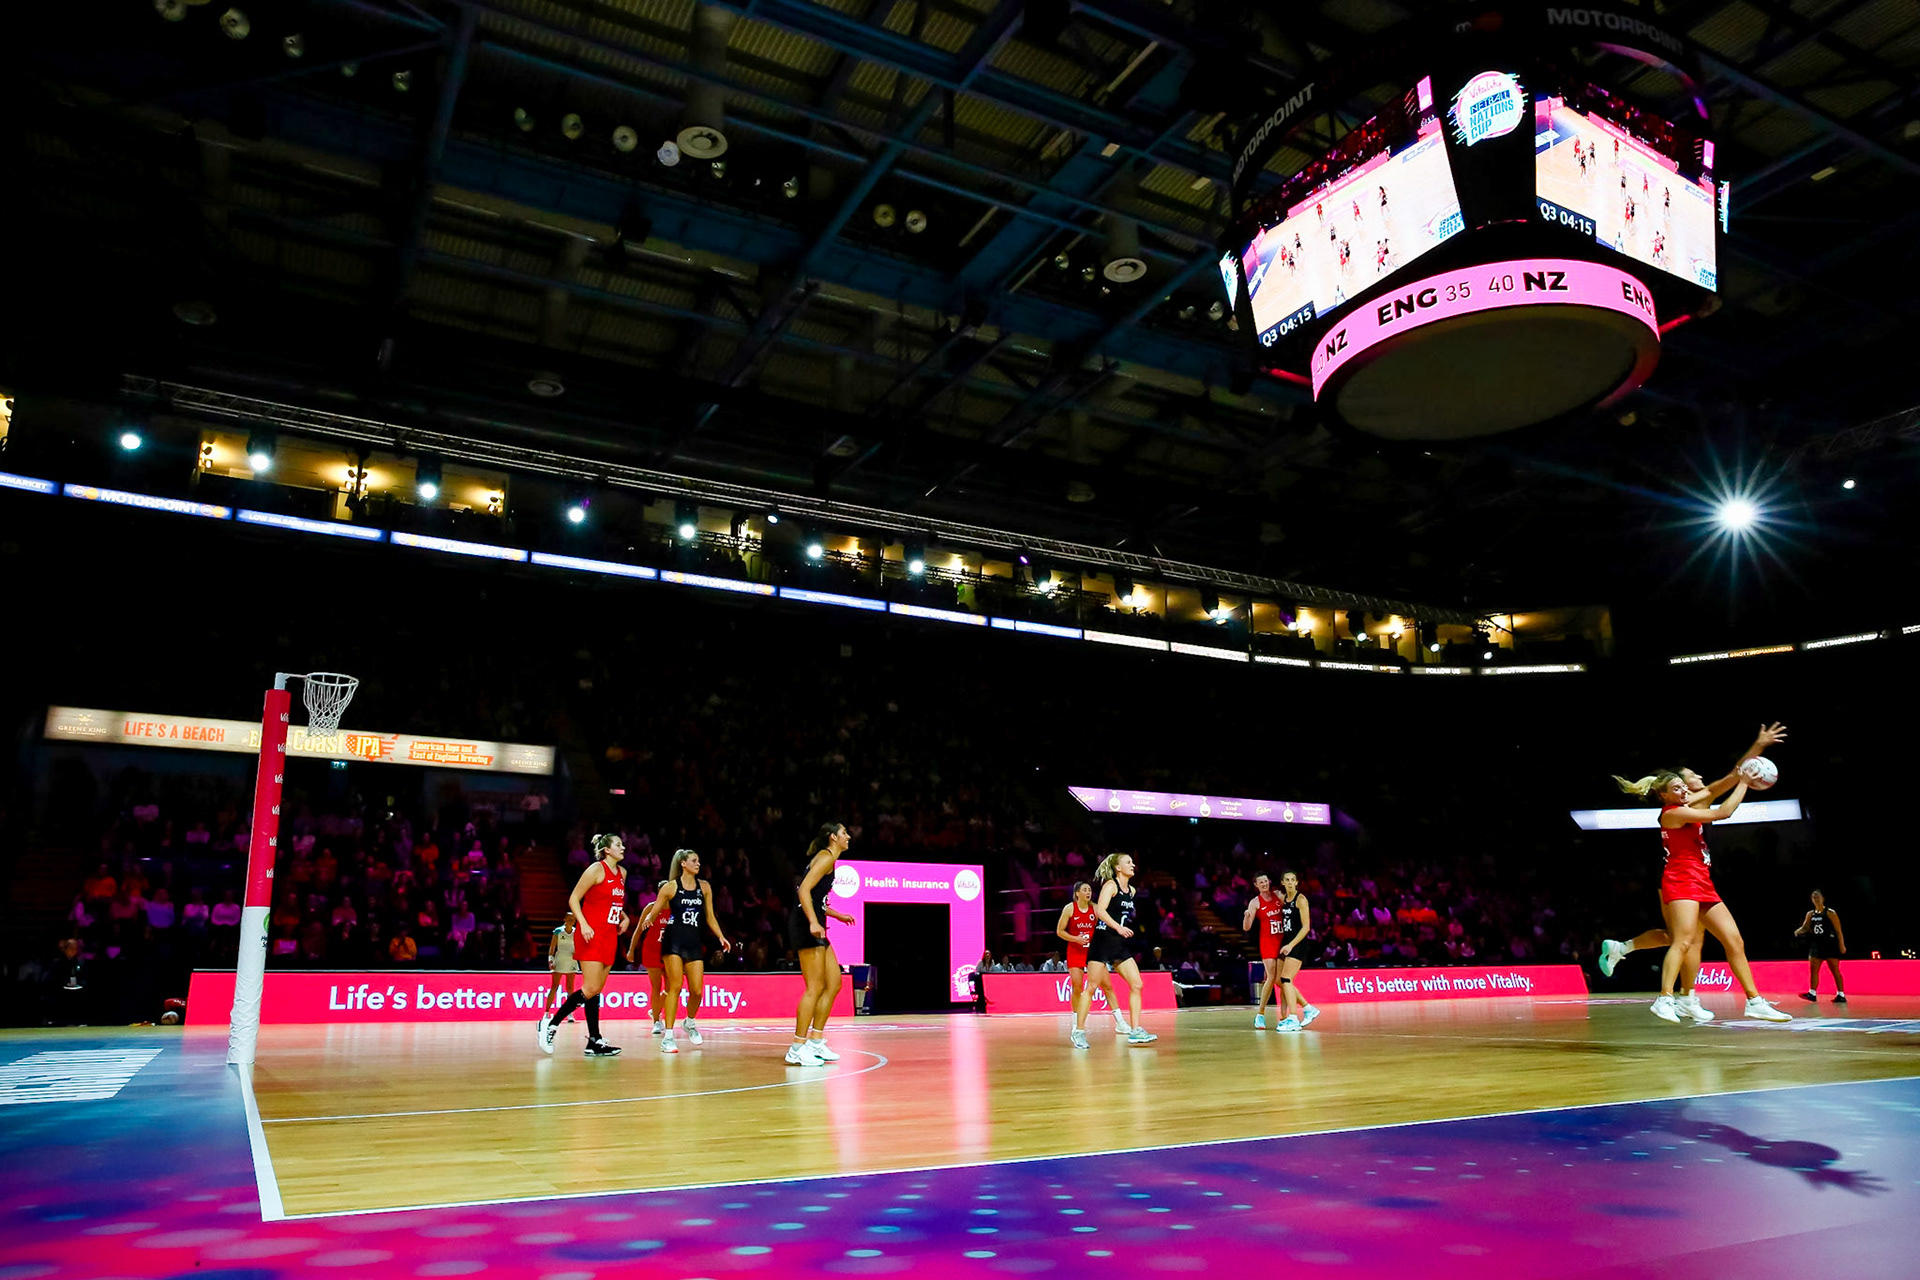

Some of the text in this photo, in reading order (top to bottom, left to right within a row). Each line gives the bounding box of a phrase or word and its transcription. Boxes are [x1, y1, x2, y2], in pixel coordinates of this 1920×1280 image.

[1546, 7, 1684, 57] MOTORPOINT
[1469, 99, 1515, 128] NATIONS
[1232, 82, 1315, 188] MOTORPOINT
[1470, 118, 1492, 140] CUP
[1540, 202, 1593, 236] Q3 04:15
[1376, 271, 1569, 327] ENG 35 40 NZ
[1262, 307, 1312, 348] Q3 04:15
[1326, 327, 1349, 362] NZ
[100, 490, 200, 514] MOTORPOINT
[124, 720, 225, 743] LIFE'S A BEACH
[355, 736, 380, 757] IPA
[413, 742, 444, 751] American
[426, 752, 434, 760] of
[434, 752, 460, 762] England
[864, 877, 950, 890] Health insurance
[681, 898, 702, 906] myob
[1813, 924, 1824, 935] GS
[1336, 972, 1535, 994] Life’s better with more Vitality.
[329, 984, 407, 1011] Life’s
[416, 984, 505, 1010] better
